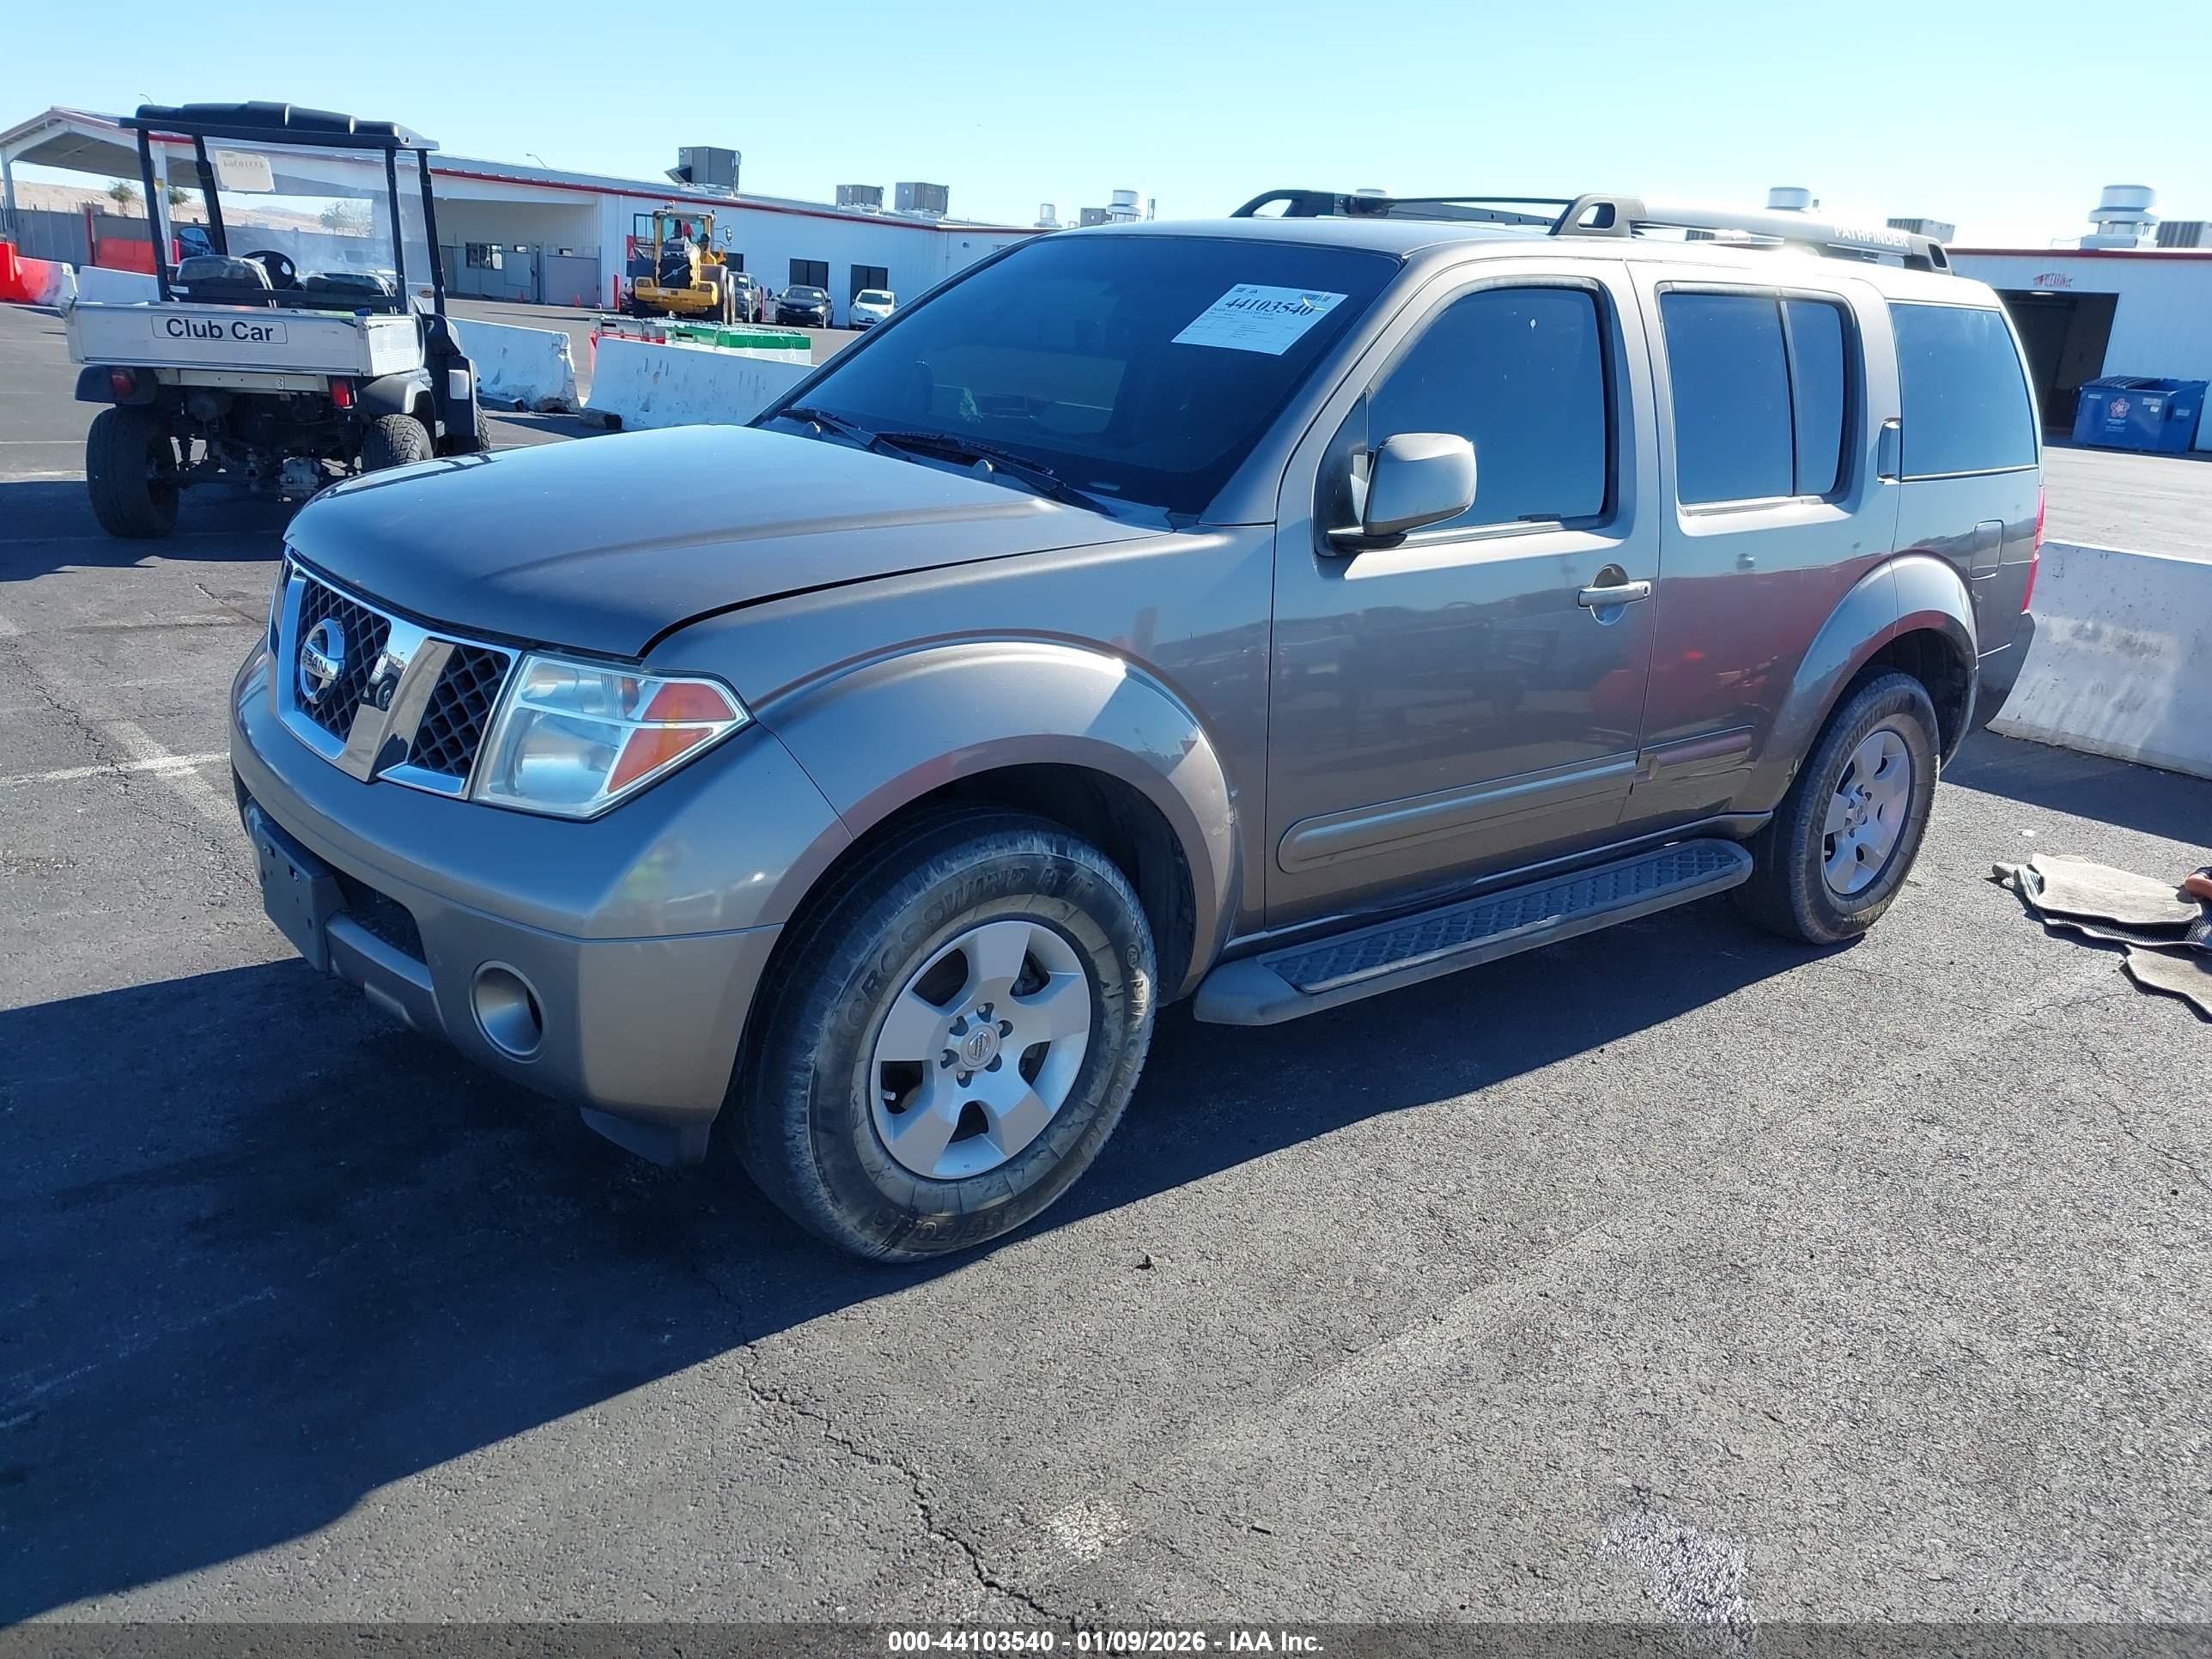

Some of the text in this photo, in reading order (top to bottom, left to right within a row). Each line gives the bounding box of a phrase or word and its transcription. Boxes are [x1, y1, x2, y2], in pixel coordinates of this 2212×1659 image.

[1834, 226, 1909, 247] PATHFINDER
[1224, 297, 1315, 316] 44103540
[166, 318, 274, 341] Club Car
